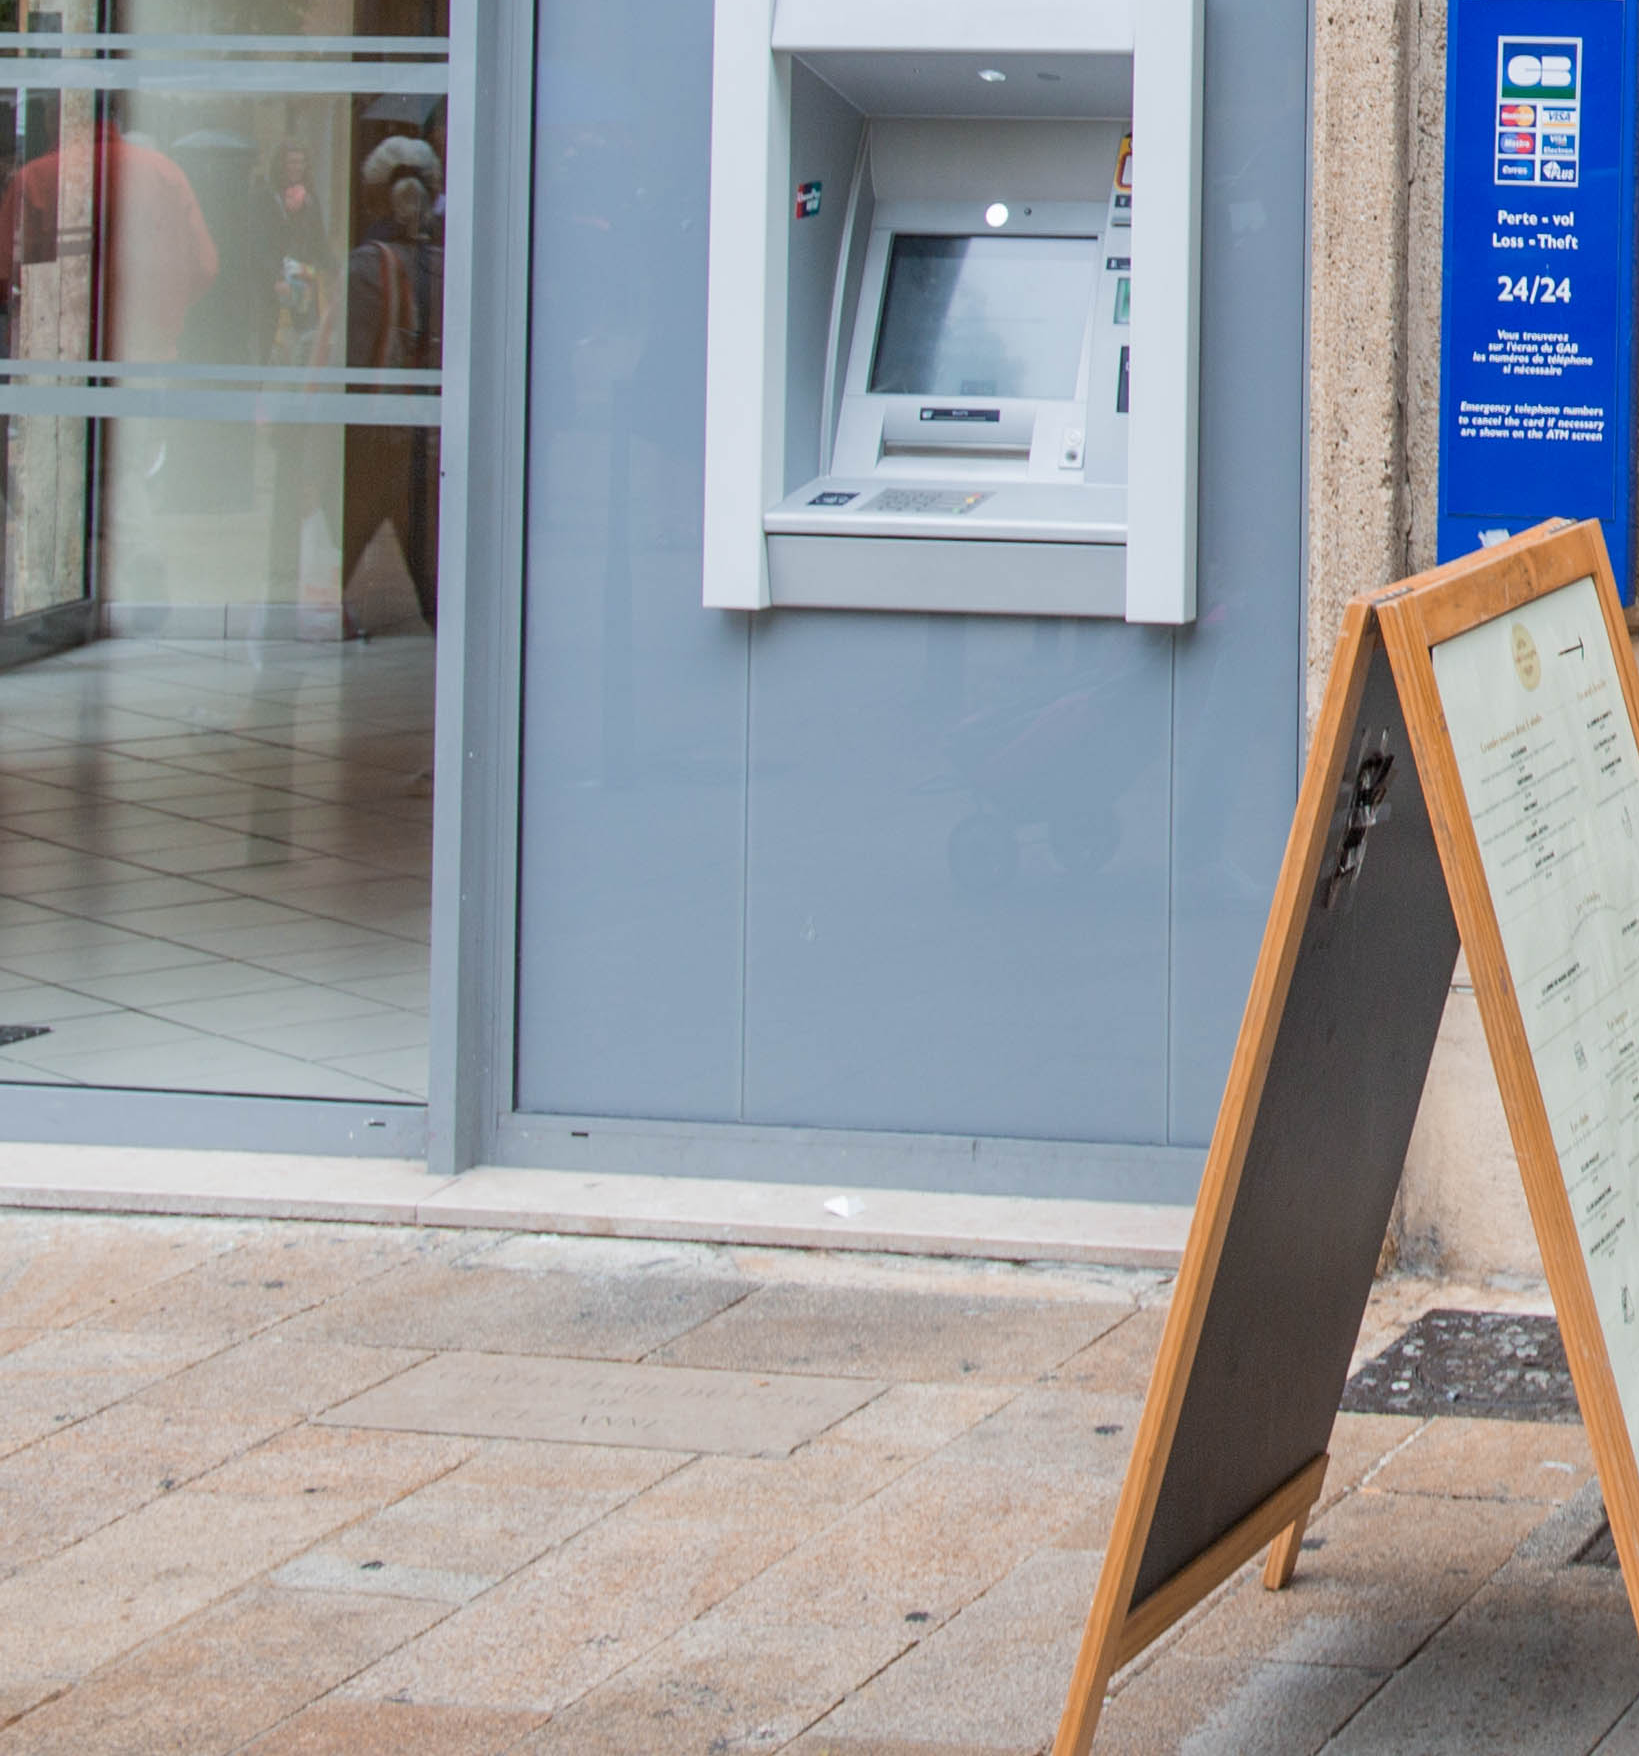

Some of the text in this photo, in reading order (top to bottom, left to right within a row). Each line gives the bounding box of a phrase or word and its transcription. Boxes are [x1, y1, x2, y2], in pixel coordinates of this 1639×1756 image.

[1497, 209, 1538, 228] Perte
[1553, 212, 1574, 228] vol
[1492, 233, 1525, 250] Loss
[1497, 276, 1572, 305] 24/24
[1460, 401, 1512, 415] Emergency
[1514, 403, 1561, 416] telephone
[1546, 428, 1569, 441] ATM
